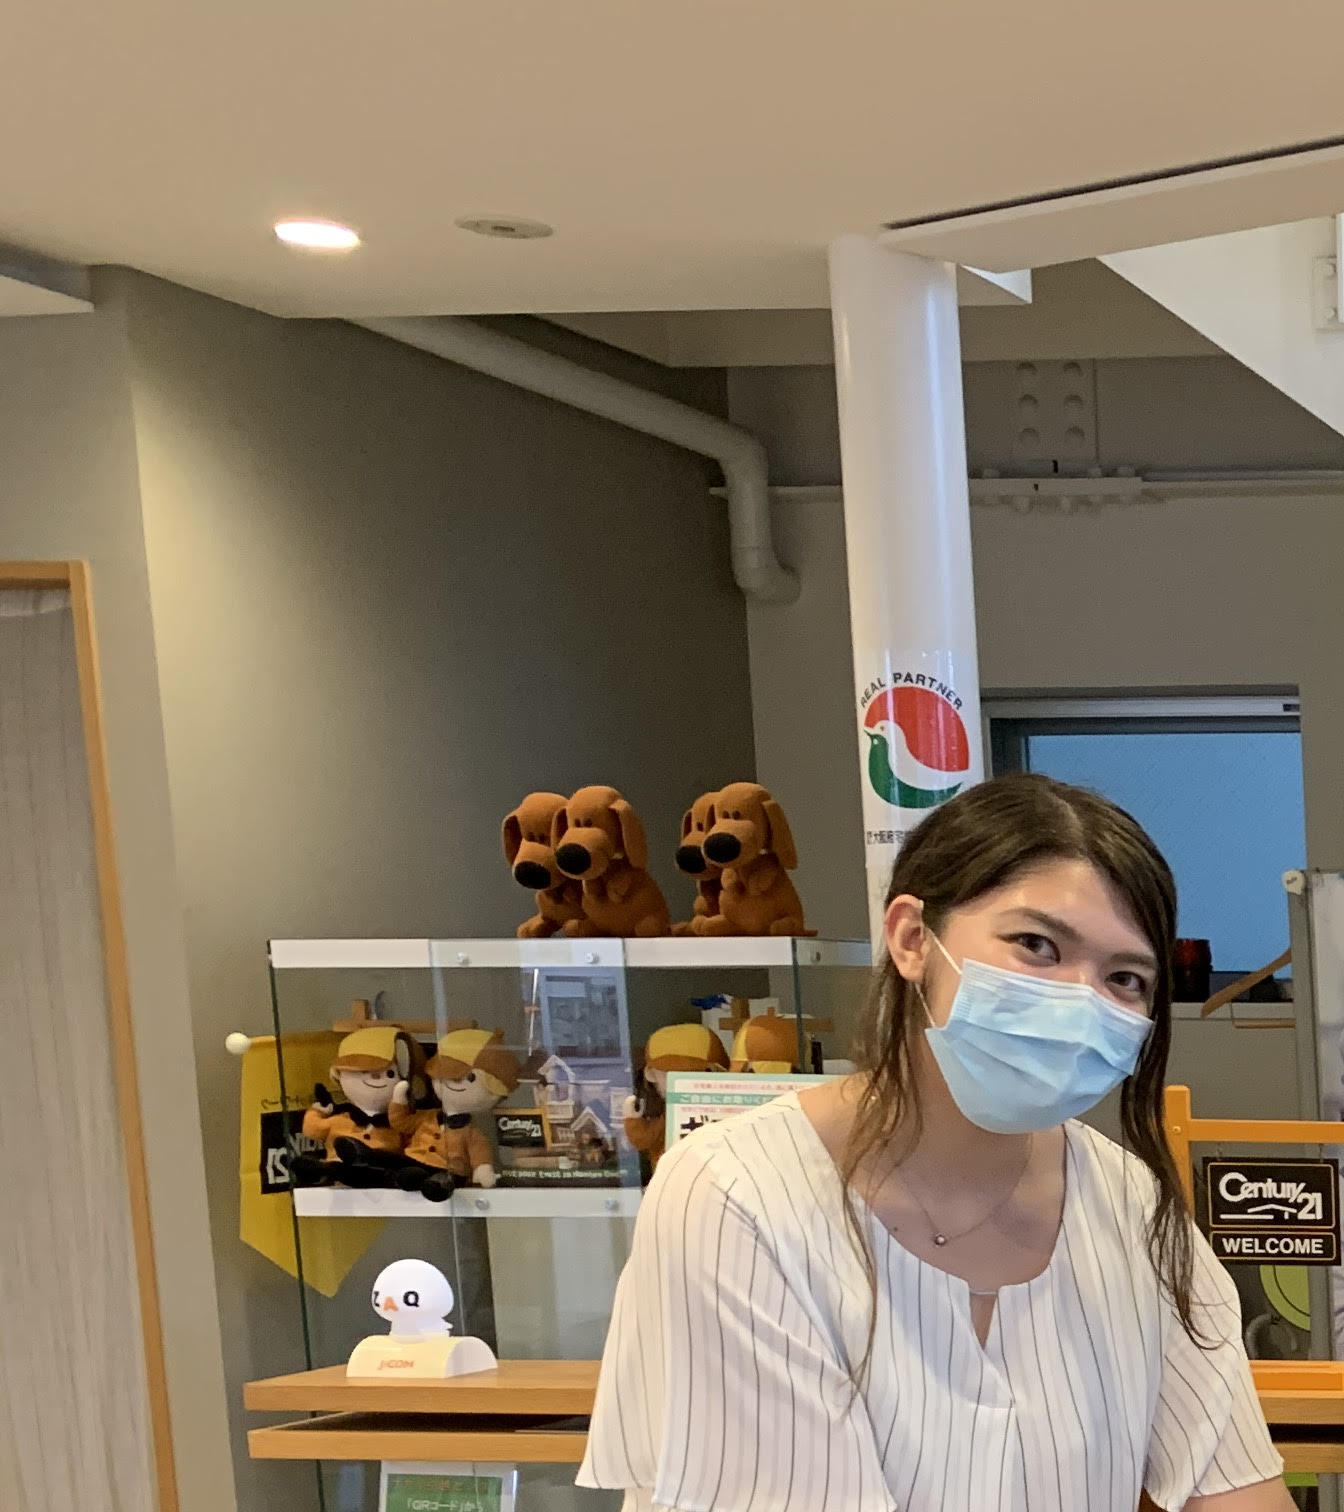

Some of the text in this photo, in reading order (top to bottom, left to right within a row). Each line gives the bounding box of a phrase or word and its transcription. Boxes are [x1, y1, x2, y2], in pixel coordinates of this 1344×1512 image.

[860, 672, 963, 711] REAL PARTNER
[1218, 1171, 1323, 1220] Century 21
[1221, 1237, 1324, 1255] WELCOME
